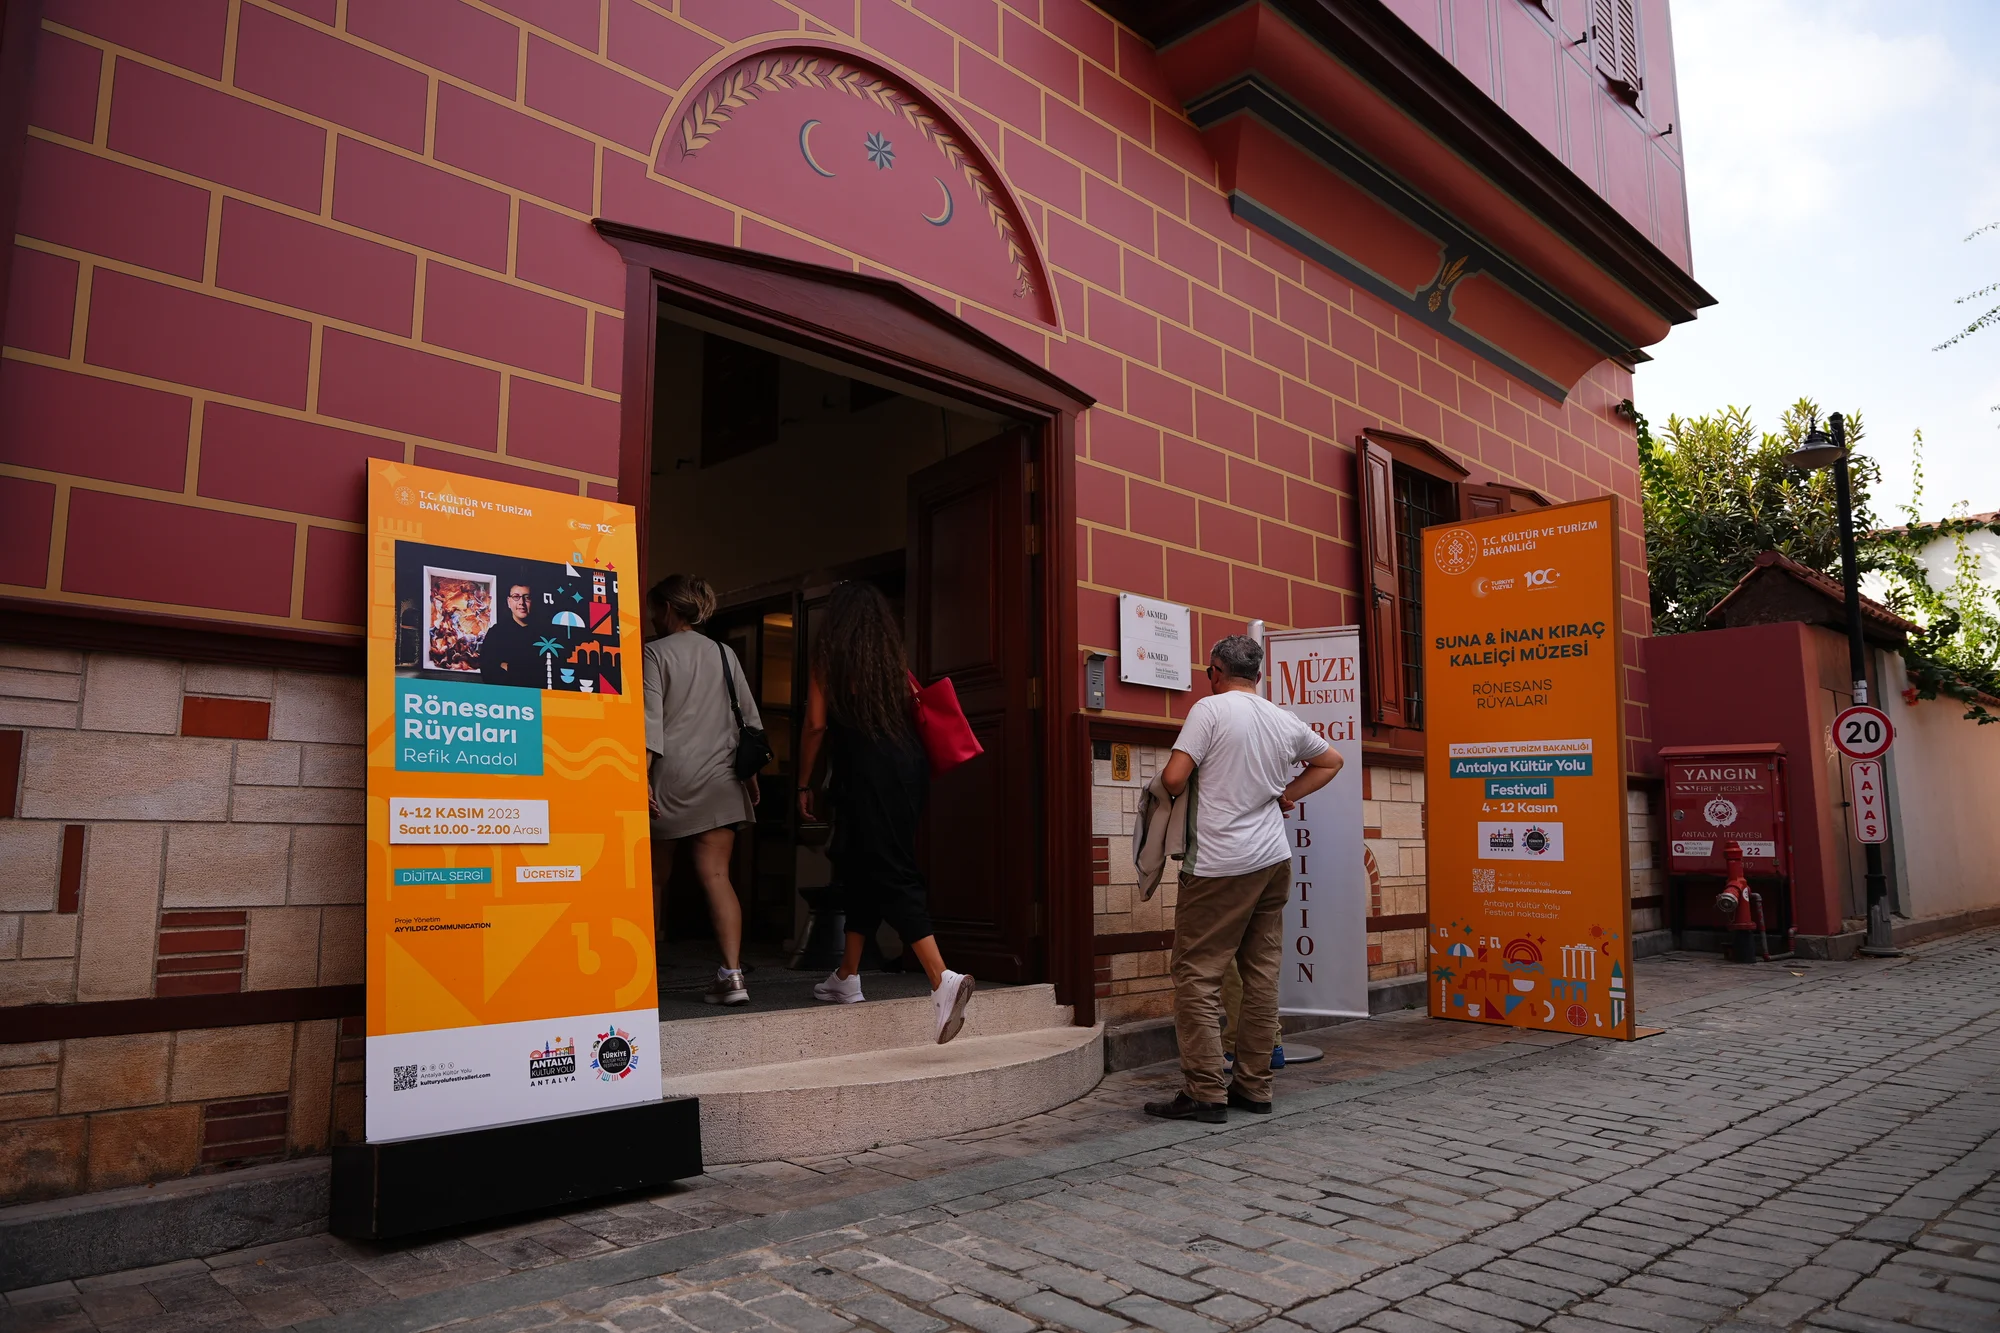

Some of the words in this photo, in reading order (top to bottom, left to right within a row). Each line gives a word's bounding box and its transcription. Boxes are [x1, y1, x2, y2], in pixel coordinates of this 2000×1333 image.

[419, 490, 437, 500] T.C.
[439, 493, 478, 507] KÜLTÜR
[480, 501, 493, 510] VE
[495, 503, 532, 517] TURİZM
[419, 500, 475, 517] BAKANLIĞI
[1482, 536, 1499, 546] T.C.
[1500, 527, 1539, 543] KÜLTÜR
[1542, 527, 1555, 537] VE
[1557, 520, 1598, 535] TURİZM
[1482, 540, 1536, 557] BAKANLIĞI
[1146, 610, 1168, 621] AKMED
[1435, 634, 1481, 650] SUNA
[1485, 632, 1497, 645] &
[1500, 628, 1544, 644] İNAN
[1549, 621, 1606, 639] KIRAÇ
[1146, 652, 1169, 662] AKMED
[1450, 648, 1515, 667] KALEİÇİ
[1520, 640, 1589, 661] MÜZESİ
[1277, 652, 1355, 706] MÜZE
[1472, 679, 1553, 695] RÖNESANS
[404, 693, 535, 721] Rönesans
[1477, 694, 1548, 709] RÜYALARI
[404, 718, 517, 745] Rüyaları
[1309, 715, 1356, 741] RGİ
[1845, 720, 1881, 744] 20
[1467, 745, 1497, 754] KÜLTÜR
[1510, 744, 1541, 753] TURİZM
[1543, 742, 1589, 752] BAKANLIĞI
[404, 748, 450, 764] Refik
[455, 750, 517, 766] Anadol
[1456, 762, 1507, 775] Antalya
[1510, 760, 1553, 772] Kültür
[1555, 759, 1586, 771] Yolu
[1684, 768, 1757, 781] YANGIN
[1490, 783, 1547, 796] Festivali
[1517, 802, 1558, 813] Kasım
[1859, 766, 1877, 837] YAVAŞ
[399, 806, 431, 818] 4-12
[436, 807, 484, 819] KASIM
[487, 808, 520, 819] 2023
[399, 824, 431, 835] Saat
[513, 825, 542, 835] Arası
[1746, 847, 1761, 856] 22
[403, 870, 447, 882] DİJİTAL
[449, 868, 484, 881] SERGİ
[523, 867, 575, 879] ÜCRETSİZ
[1483, 900, 1514, 908] Antalya
[1516, 901, 1540, 909] Kültür
[1543, 903, 1561, 911] Yolu
[1484, 908, 1515, 917] Festival
[1517, 911, 1560, 919] noktasıdır.
[394, 917, 412, 925] Proje
[394, 924, 428, 933] AYYILDIZ
[429, 922, 491, 931] COMMUNICATION
[532, 1056, 574, 1069] ANTALYA
[556, 1065, 574, 1074] YOLU
[530, 1076, 576, 1087] ANTALYA
